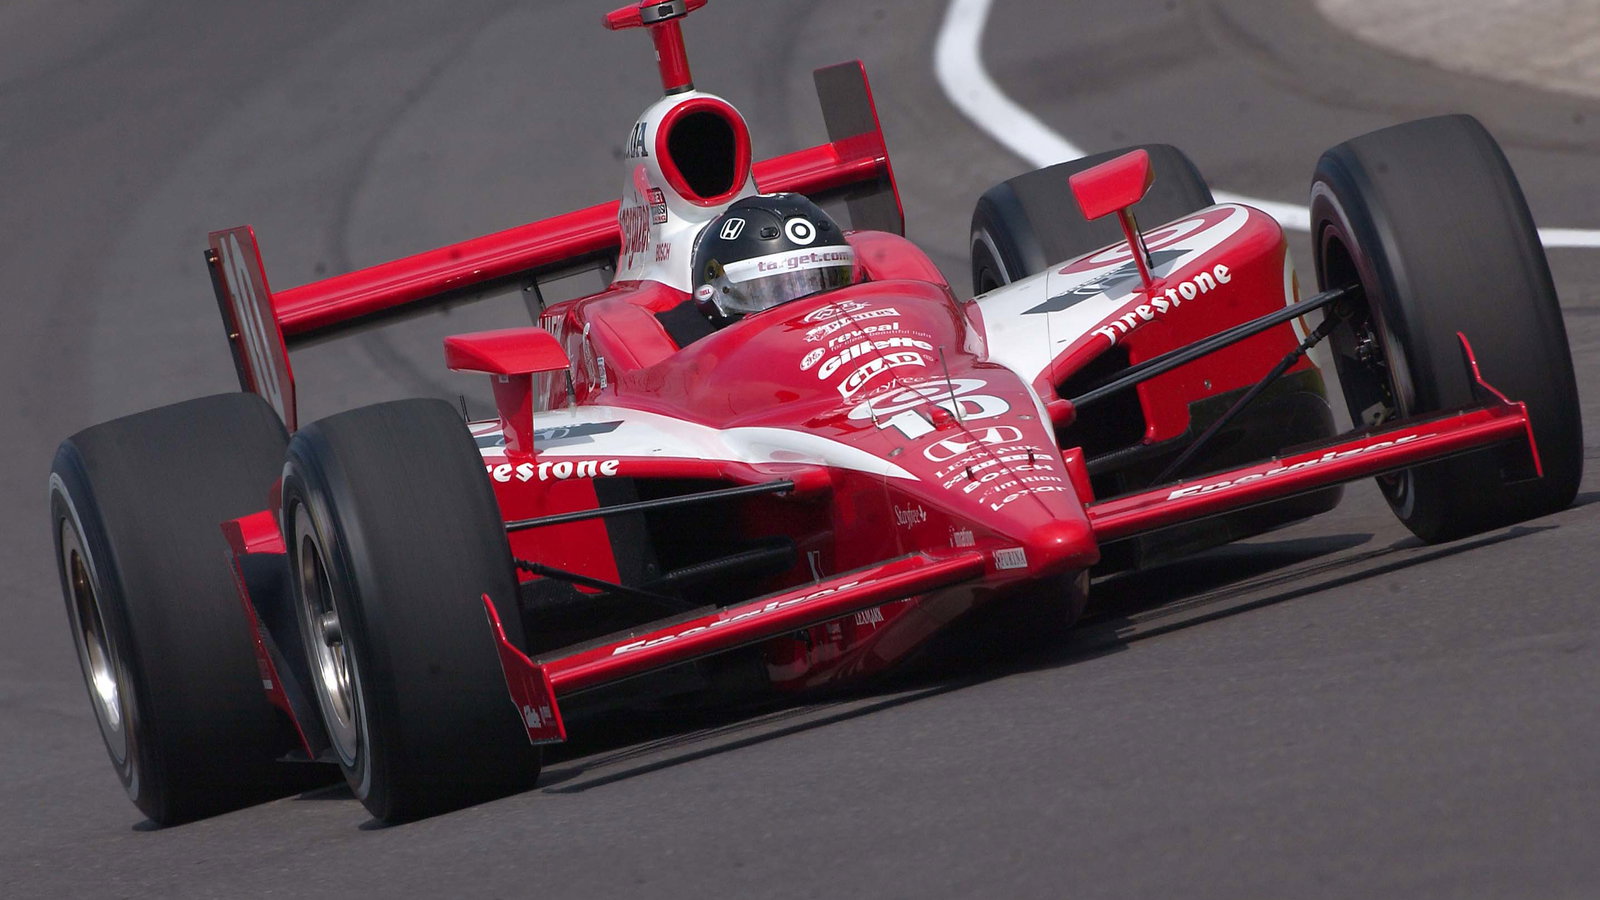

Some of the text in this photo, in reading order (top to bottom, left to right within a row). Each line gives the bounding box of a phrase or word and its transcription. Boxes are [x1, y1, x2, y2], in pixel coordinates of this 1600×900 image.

[1091, 263, 1232, 346] Firestone
[829, 322, 899, 348] reveal
[818, 337, 934, 380] Gillette
[875, 395, 1010, 440] 10
[963, 464, 1054, 494] BOSCH
